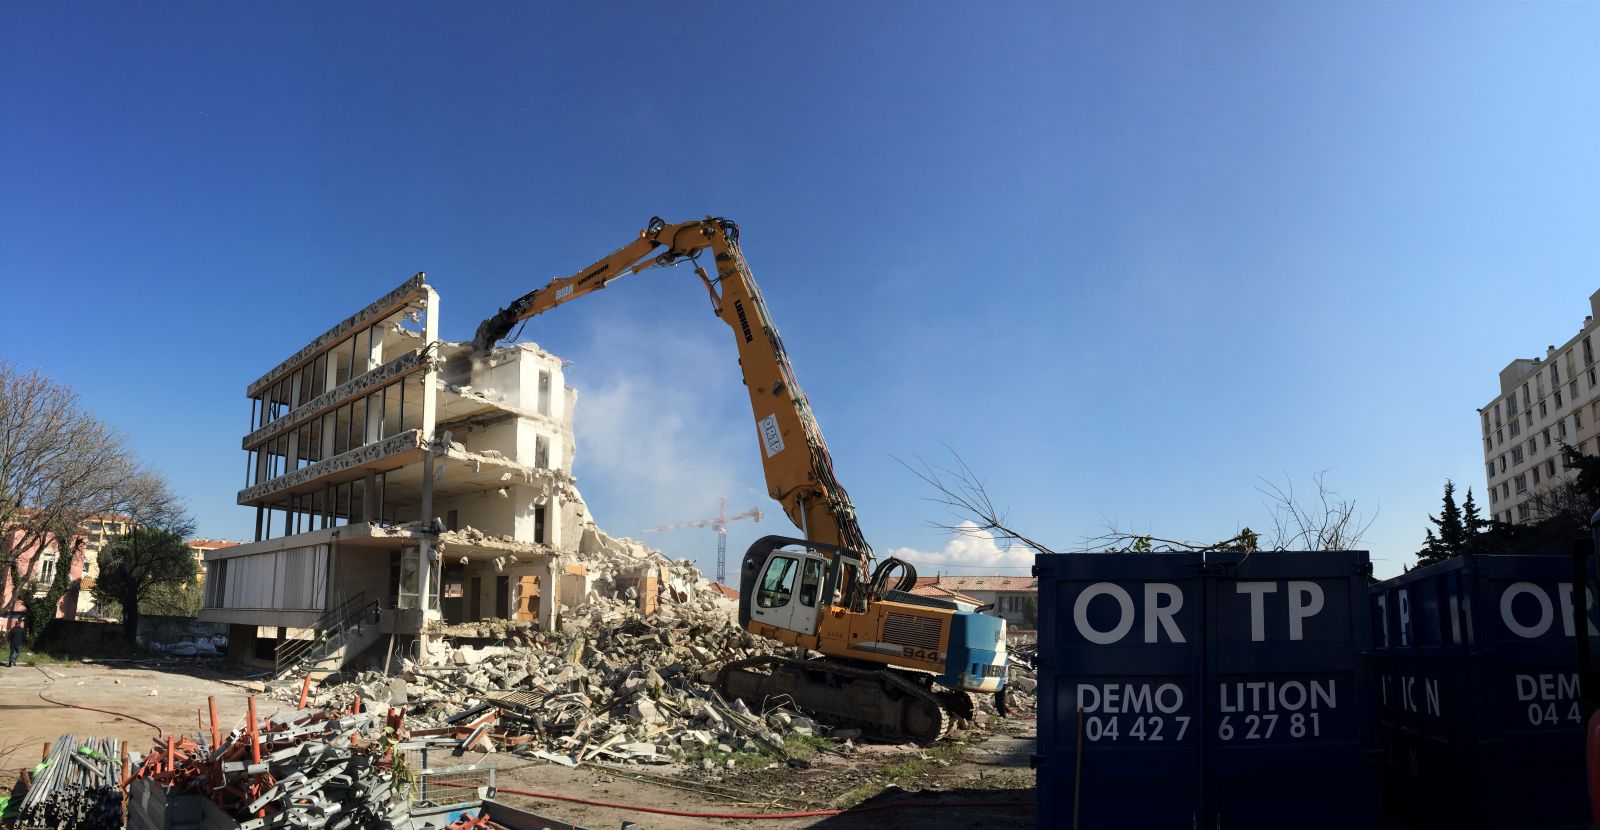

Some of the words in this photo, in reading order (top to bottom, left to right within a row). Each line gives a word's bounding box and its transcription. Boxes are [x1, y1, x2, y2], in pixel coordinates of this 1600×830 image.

[734, 299, 753, 344] LIEBHERR
[762, 416, 781, 453] ORTP
[1073, 581, 1187, 645] OR
[1236, 580, 1325, 642] TP
[903, 647, 939, 662] 944
[1076, 682, 1184, 714] DEMO
[1220, 679, 1337, 713] LITION
[1515, 673, 1581, 701] DEM
[1086, 715, 1119, 742] 04
[1128, 715, 1164, 742] 42
[1175, 716, 1191, 741] 7
[1218, 715, 1235, 741] 6
[1244, 714, 1279, 740] 27
[1289, 712, 1320, 738] 81
[1527, 702, 1559, 726] 04
[1567, 701, 1582, 725] 4
